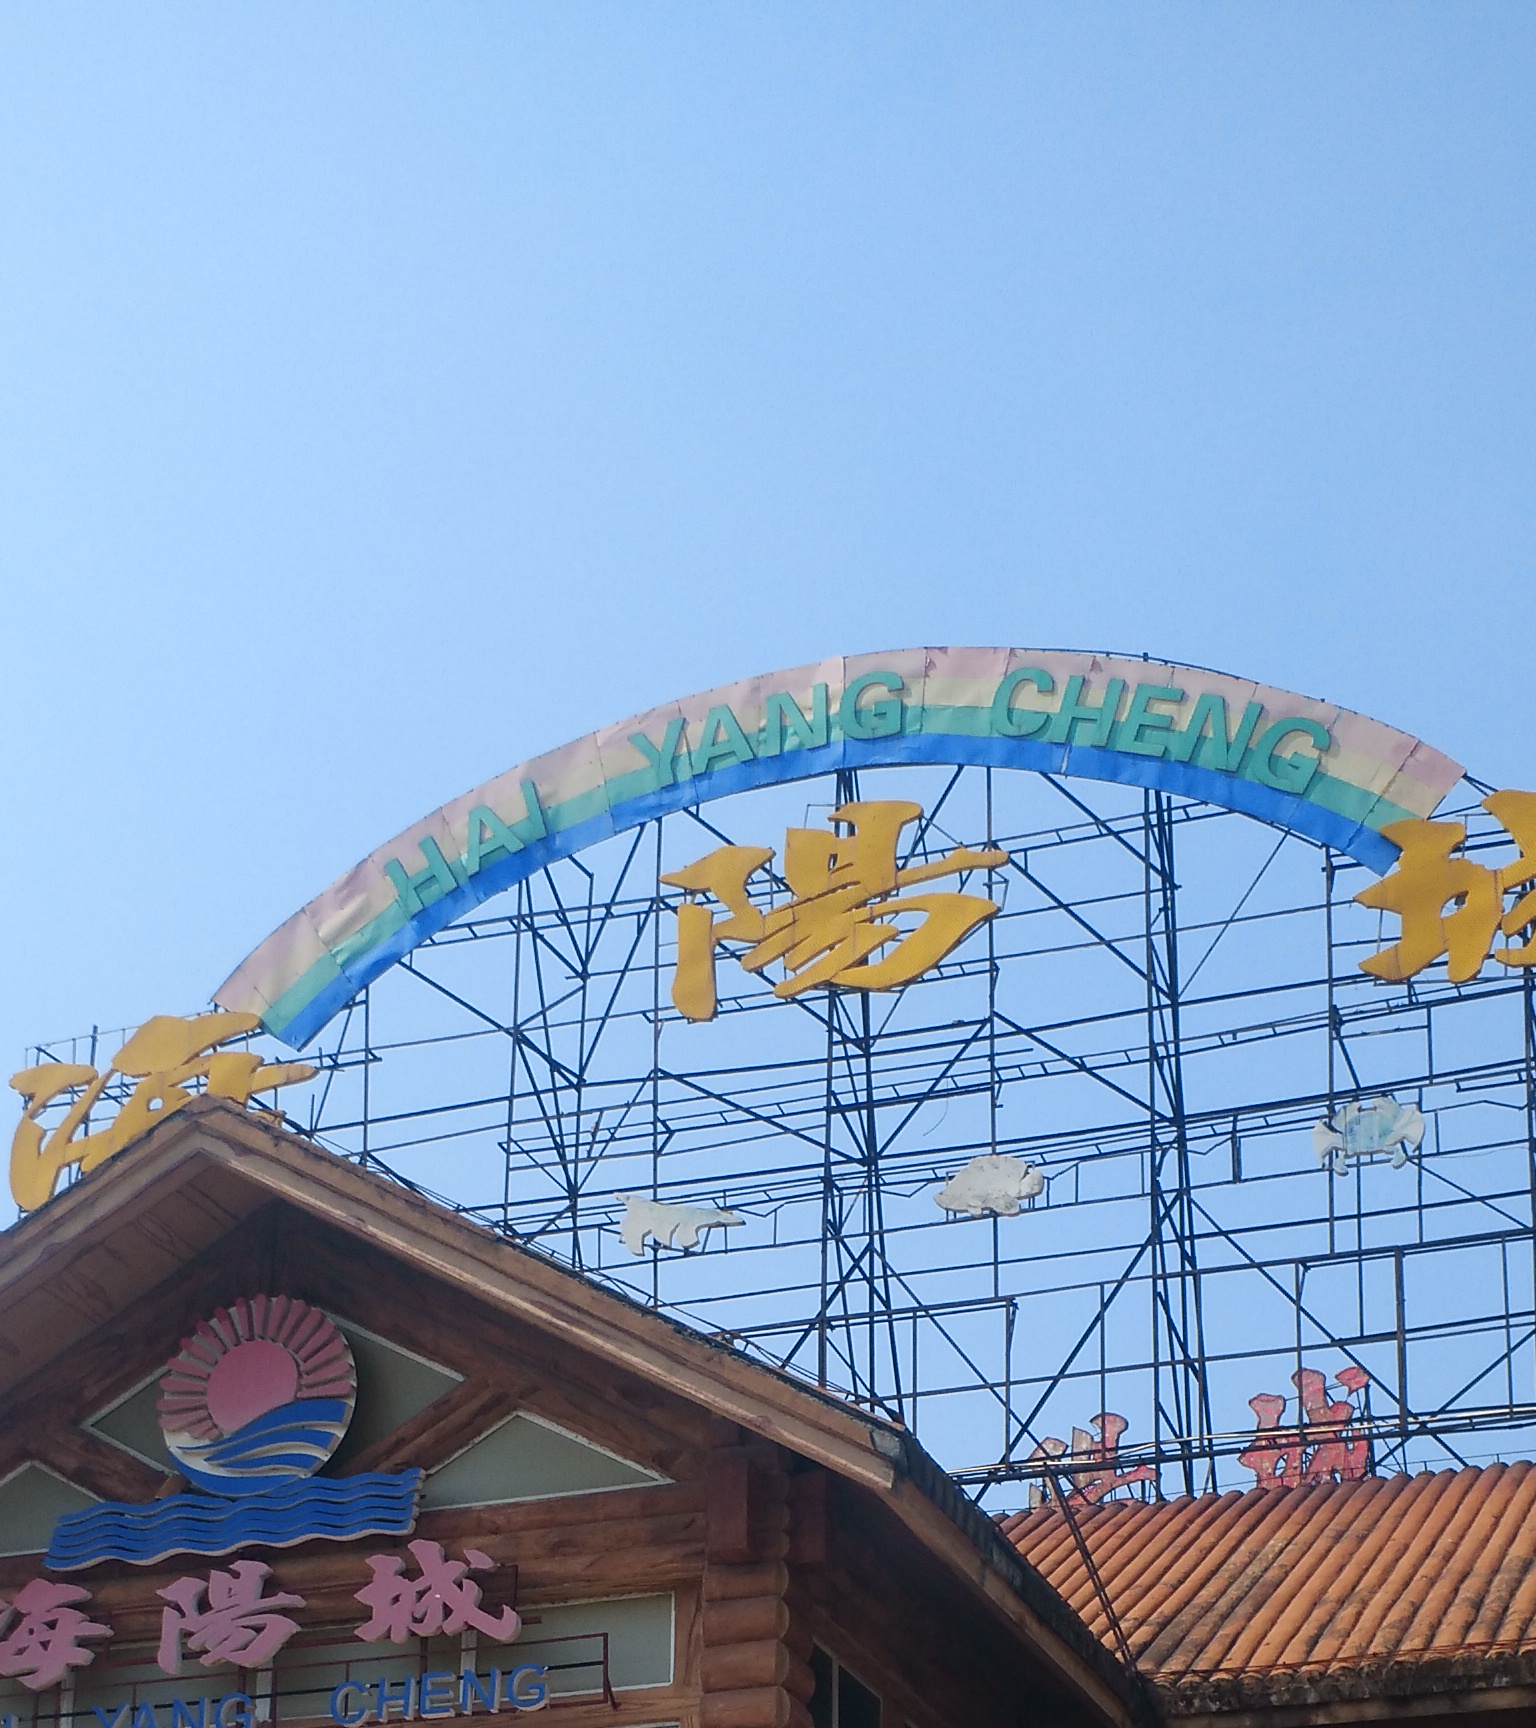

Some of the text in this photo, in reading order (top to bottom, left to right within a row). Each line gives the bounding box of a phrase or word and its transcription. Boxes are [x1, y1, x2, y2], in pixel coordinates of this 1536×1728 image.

[383, 664, 1334, 916] HAI YANG CHENG
[330, 1662, 551, 1728] CHENG
